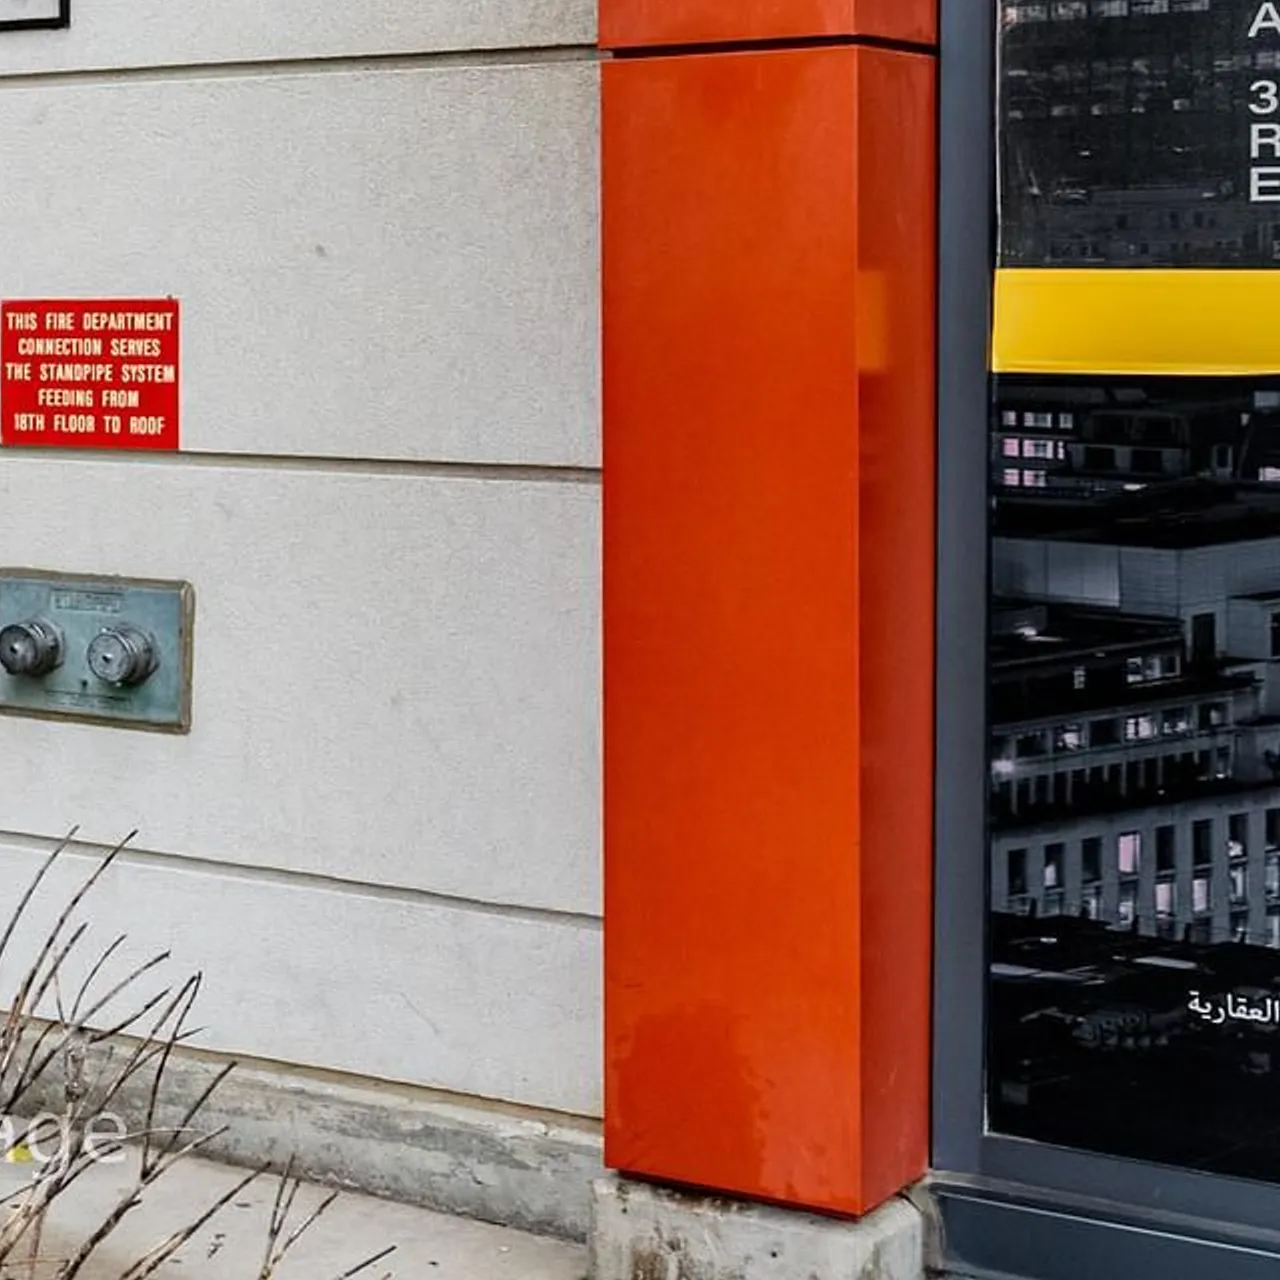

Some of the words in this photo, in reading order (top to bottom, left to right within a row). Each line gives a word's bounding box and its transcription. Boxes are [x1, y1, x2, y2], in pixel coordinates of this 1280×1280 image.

[6, 312, 37, 330] THIS
[46, 312, 75, 330] FIRE
[82, 312, 173, 331] DEPARTMENT
[18, 338, 102, 356] CONNECTION
[110, 338, 161, 357] SERVES
[6, 363, 32, 381] THE
[39, 363, 113, 382] STANDPIPE
[121, 364, 176, 383] SYSTEM
[38, 388, 94, 407] FEEDING
[102, 390, 139, 408] FROM
[14, 413, 45, 431] 18TH
[53, 414, 95, 433] FLOOR
[103, 415, 121, 433] TO
[129, 416, 165, 435] ROOF
